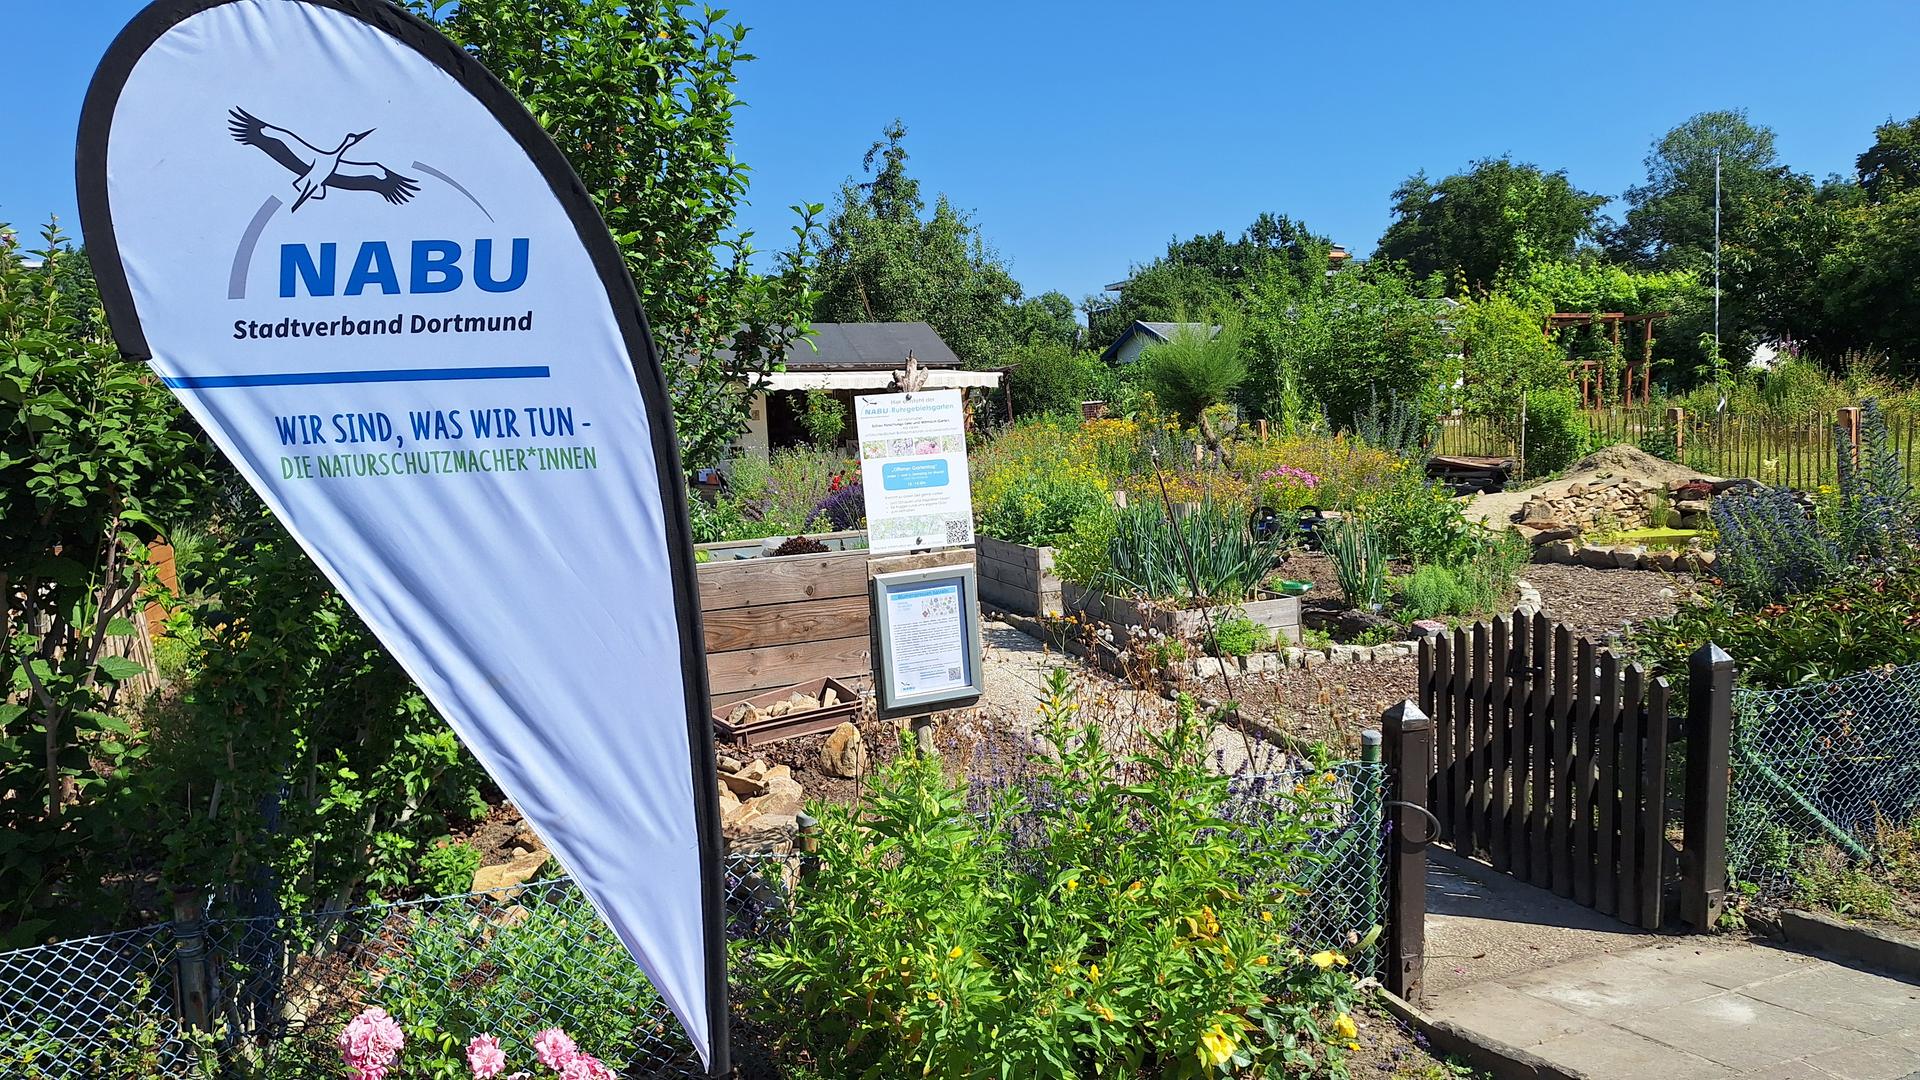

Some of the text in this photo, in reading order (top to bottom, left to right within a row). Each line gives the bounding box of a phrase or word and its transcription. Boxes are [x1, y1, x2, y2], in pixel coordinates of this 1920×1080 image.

[279, 237, 530, 298] NABU
[232, 311, 533, 340] Stadtverband Dortmund
[864, 407, 889, 415] NABU
[275, 414, 327, 446] WIR
[332, 411, 403, 448] SIND,
[409, 409, 464, 441] WAS
[470, 407, 520, 439] WIR
[524, 406, 575, 437] TUN
[280, 455, 314, 480] DIE
